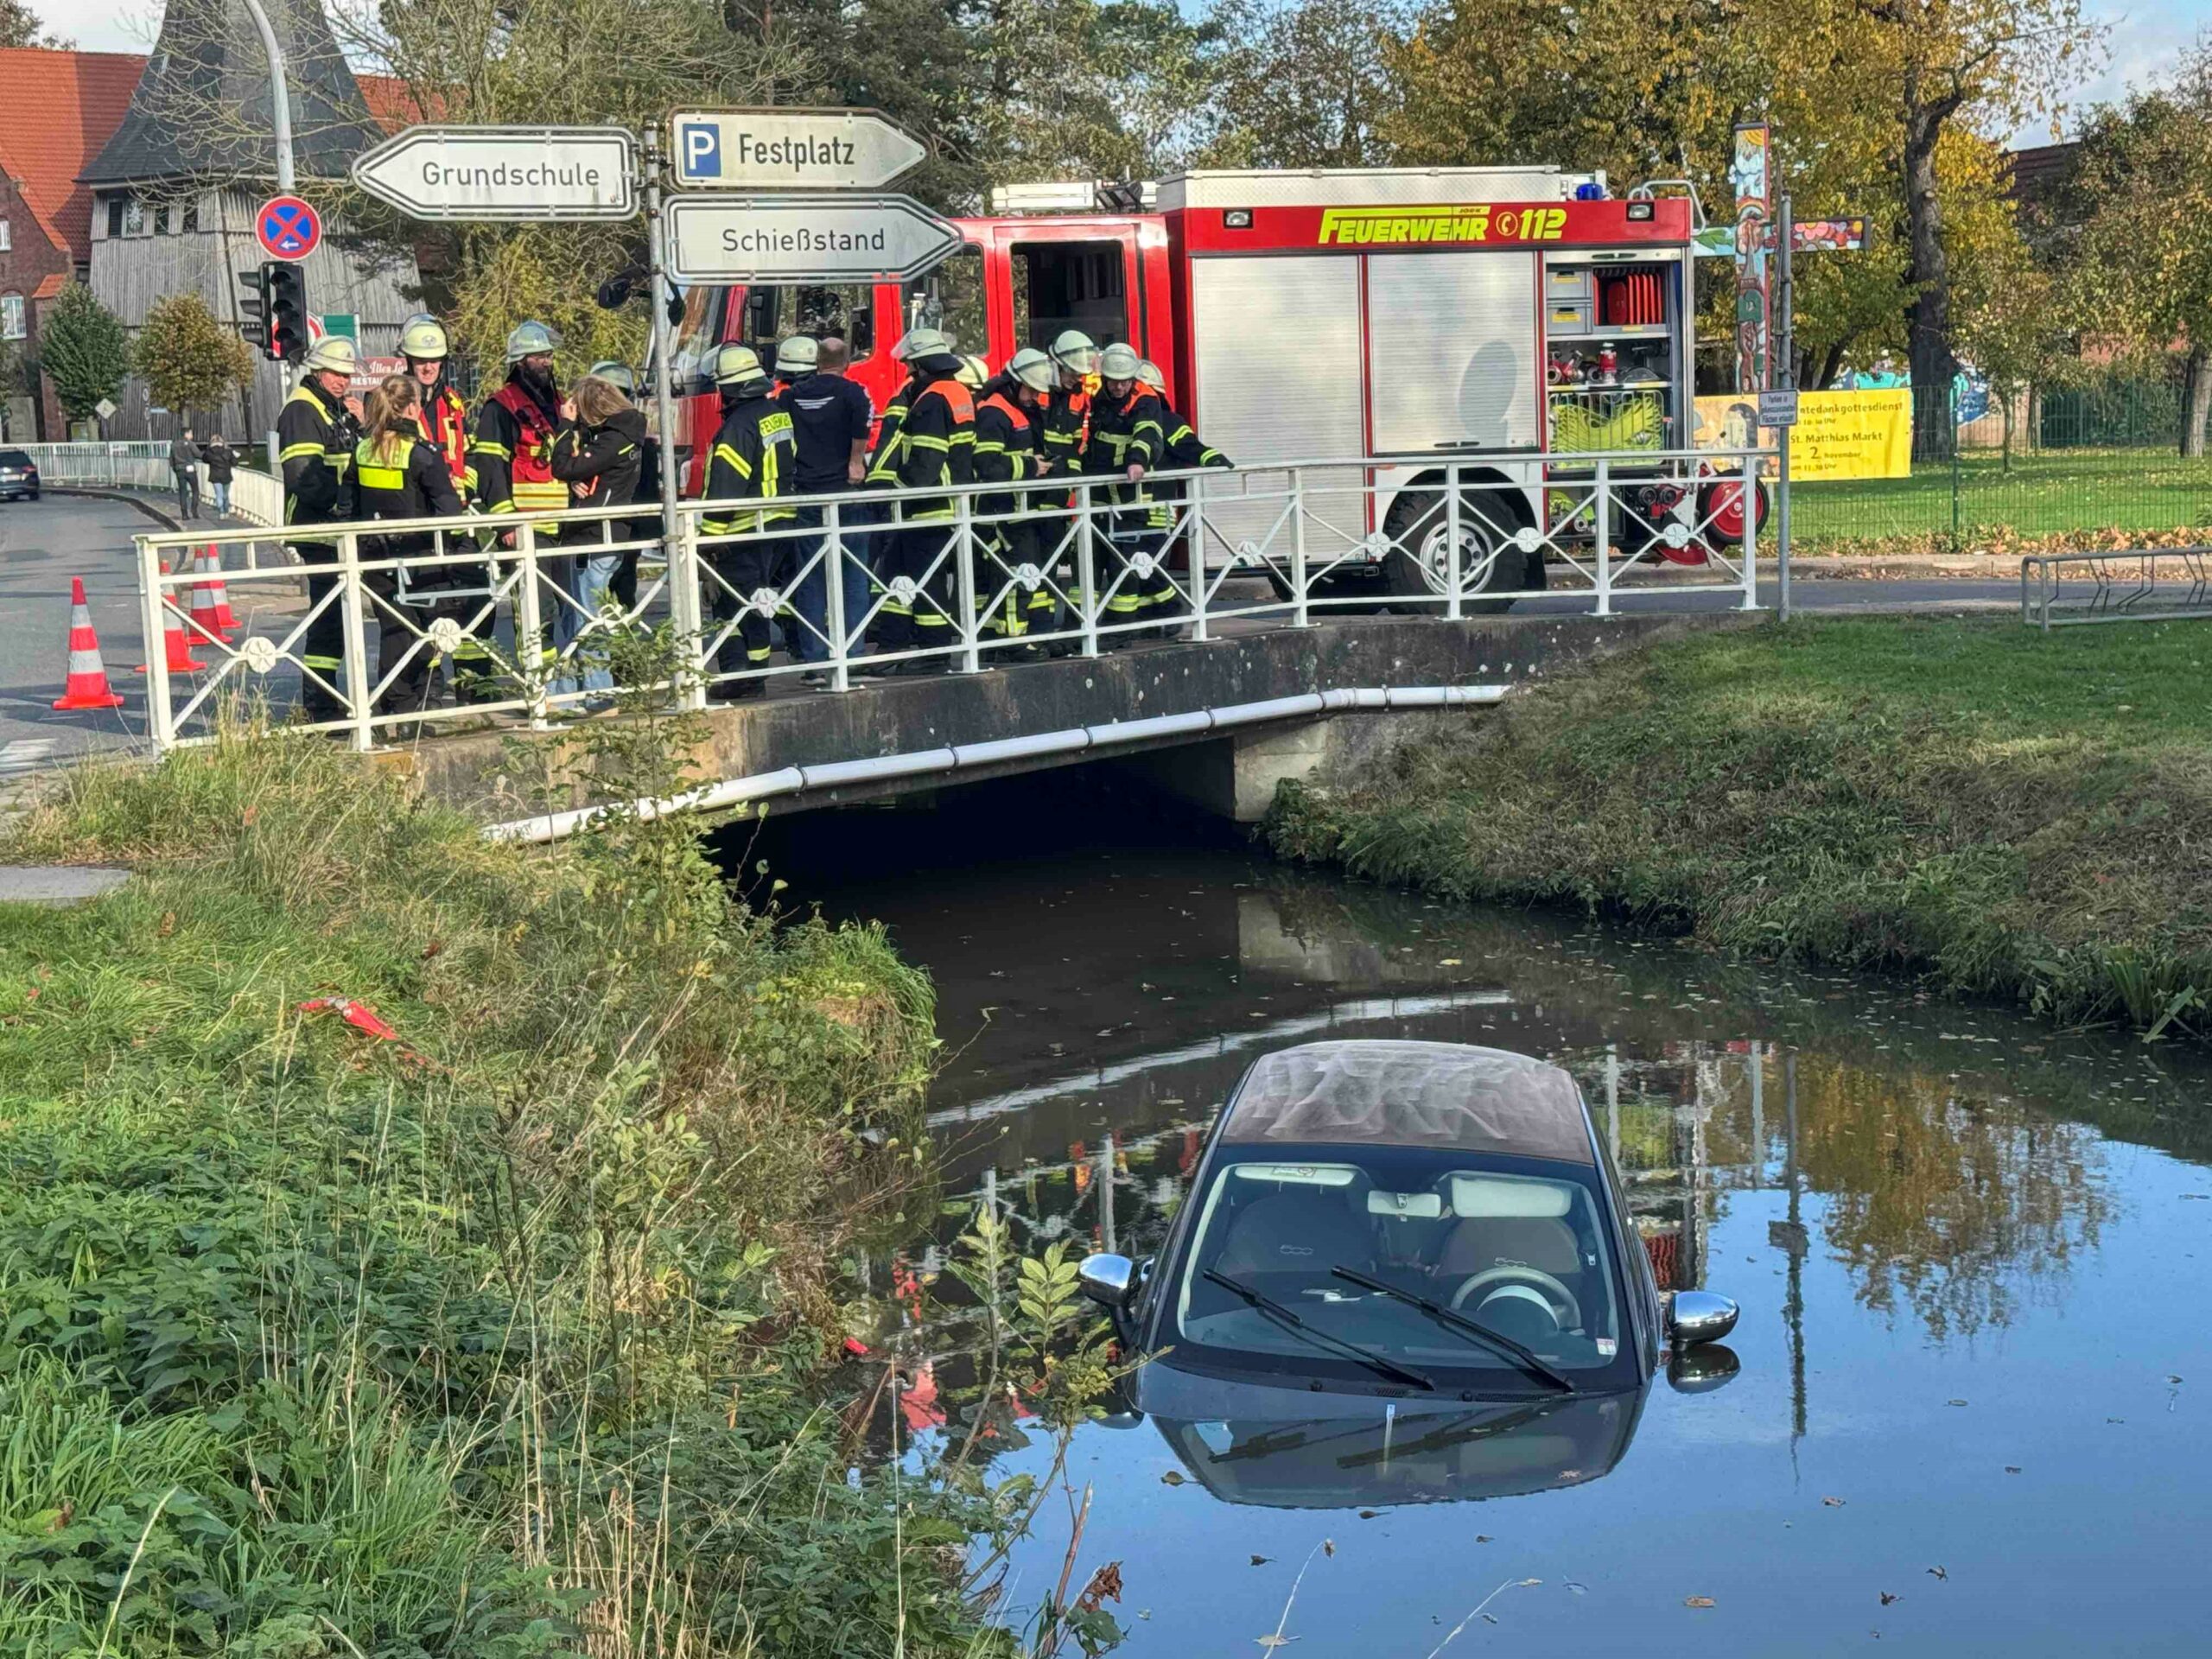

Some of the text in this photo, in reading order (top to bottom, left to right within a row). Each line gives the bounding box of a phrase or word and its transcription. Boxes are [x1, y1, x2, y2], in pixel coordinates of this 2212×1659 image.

[688, 129, 855, 172] P Festplatz
[422, 162, 600, 188] Grundschule
[1318, 205, 1567, 245] FEUERWEHR 112
[721, 228, 886, 253] Schießstand
[1800, 402, 1903, 415] ntedankgottesdienst
[1806, 433, 1849, 443] Matthias
[1852, 432, 1882, 441] Markt
